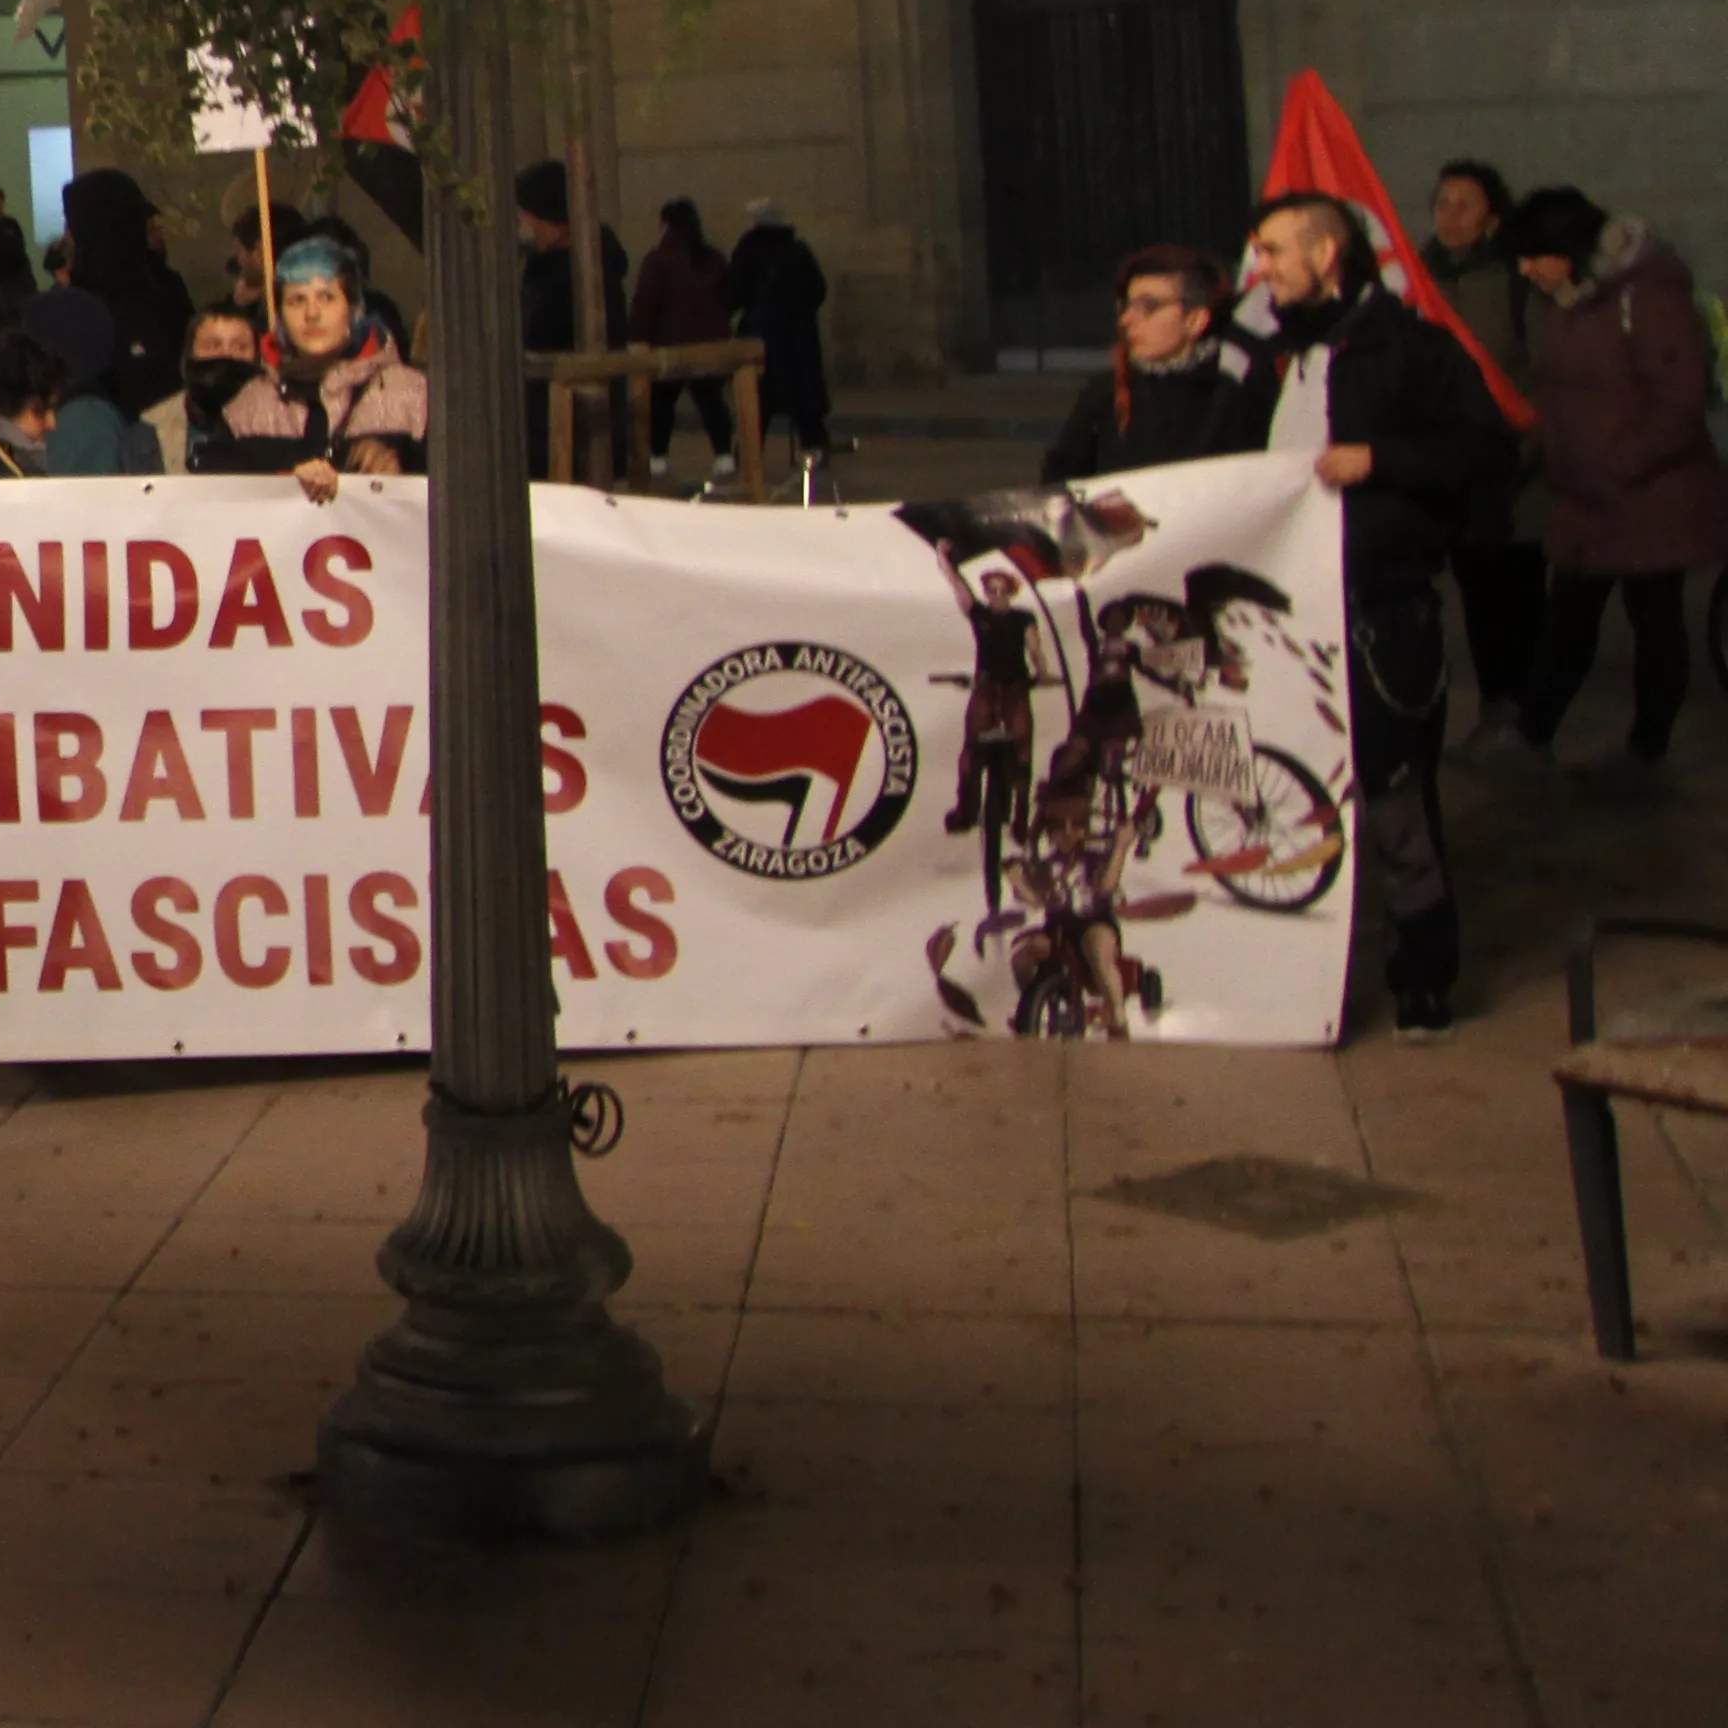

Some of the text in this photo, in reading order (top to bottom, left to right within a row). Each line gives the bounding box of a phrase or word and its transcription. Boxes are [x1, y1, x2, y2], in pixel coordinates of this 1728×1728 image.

[665, 645, 913, 821] COORDINADORA ANTIFASCISTA
[711, 827, 868, 876] ZARAGOZA
